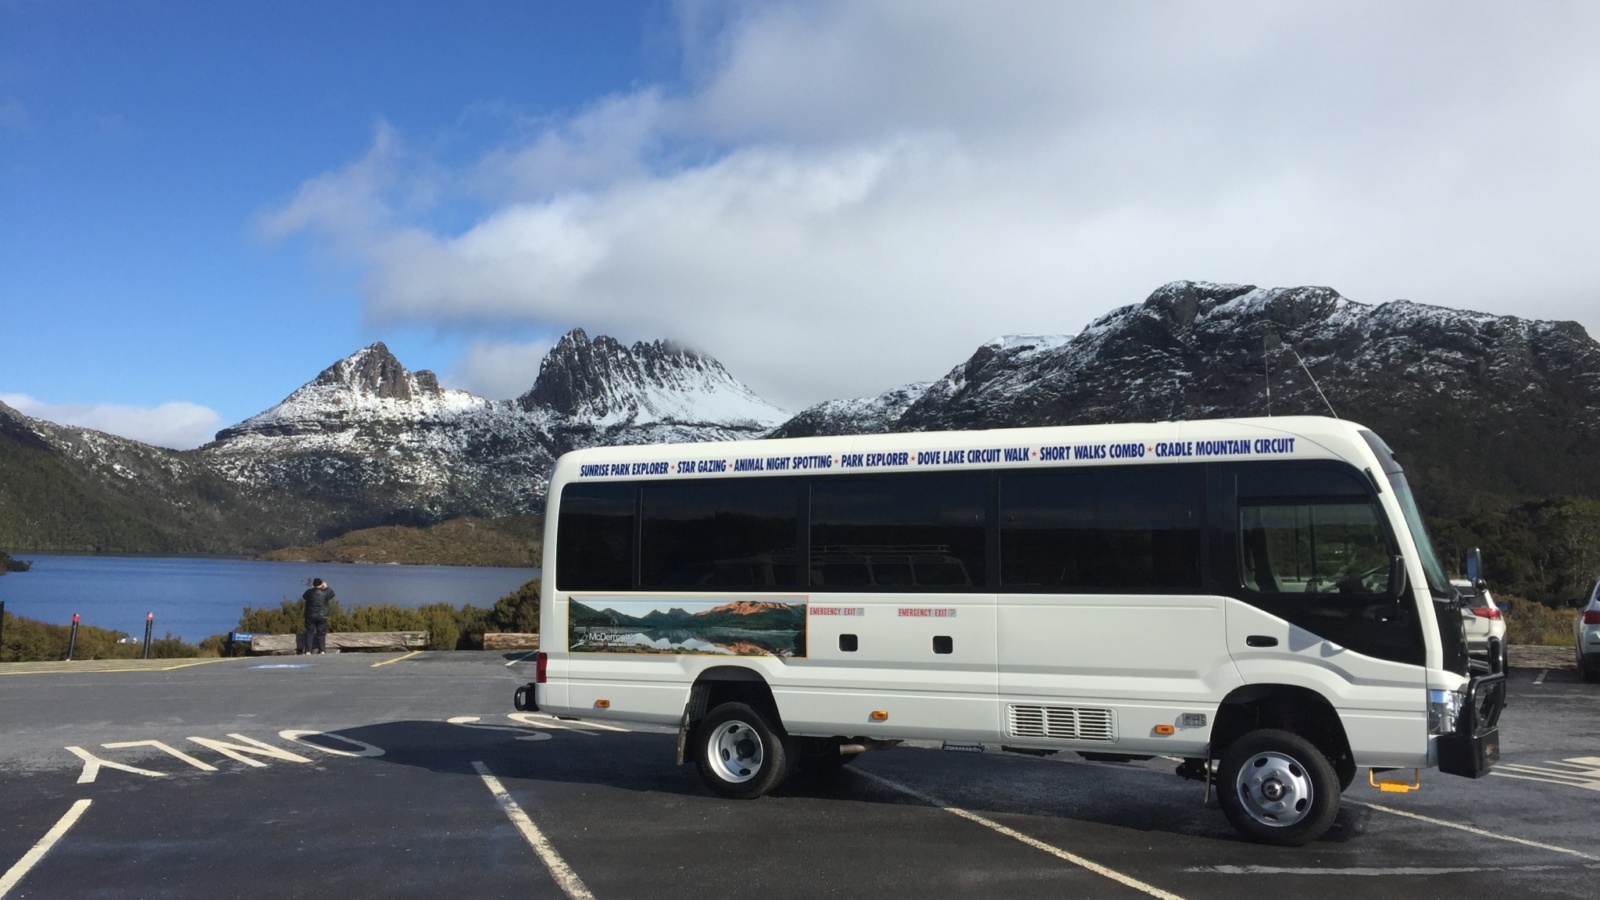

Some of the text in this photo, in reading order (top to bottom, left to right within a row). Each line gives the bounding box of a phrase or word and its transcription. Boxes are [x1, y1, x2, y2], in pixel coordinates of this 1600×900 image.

[580, 438, 1296, 477] SUNRISE PARK EXPLORER STAR GAZING ANIMAL NIGHT SPOTTING PARK EXPLORER DOVE LAKE CIRCUIT WALK SHORT WALKS COMBO CRADLE MOUNTAIN CIRCUIT
[809, 607, 856, 616] EMERGENCY EXIT
[898, 608, 947, 617] EMERGENCY EXIT
[64, 729, 386, 784] ONLY
